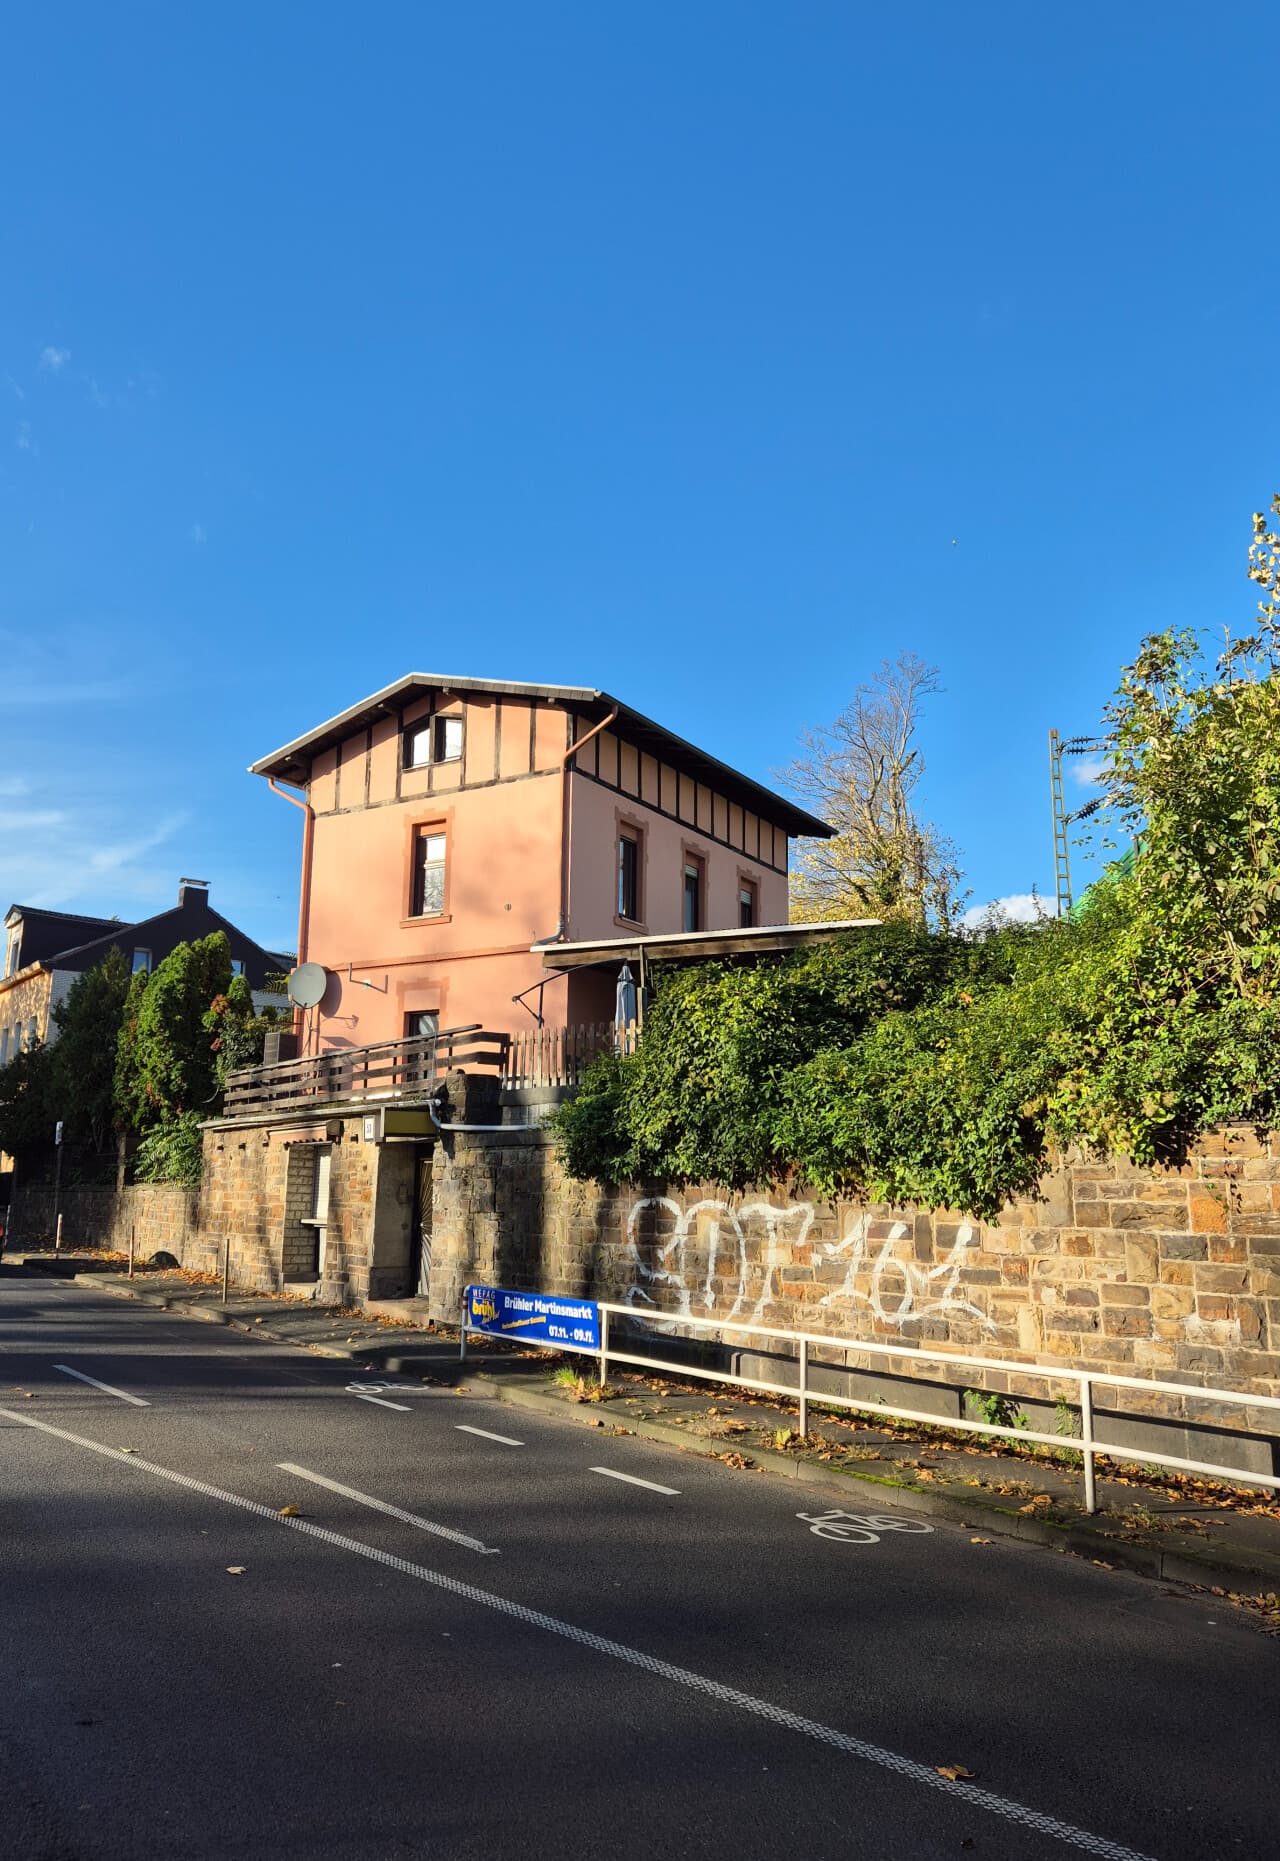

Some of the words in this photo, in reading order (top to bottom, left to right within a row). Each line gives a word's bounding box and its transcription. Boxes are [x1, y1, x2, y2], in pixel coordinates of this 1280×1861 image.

[504, 1296, 534, 1312] Brühler
[534, 1299, 593, 1320] Martinsmarkt
[548, 1325, 569, 1339] 07.11.
[573, 1328, 594, 1343] 09.11.
